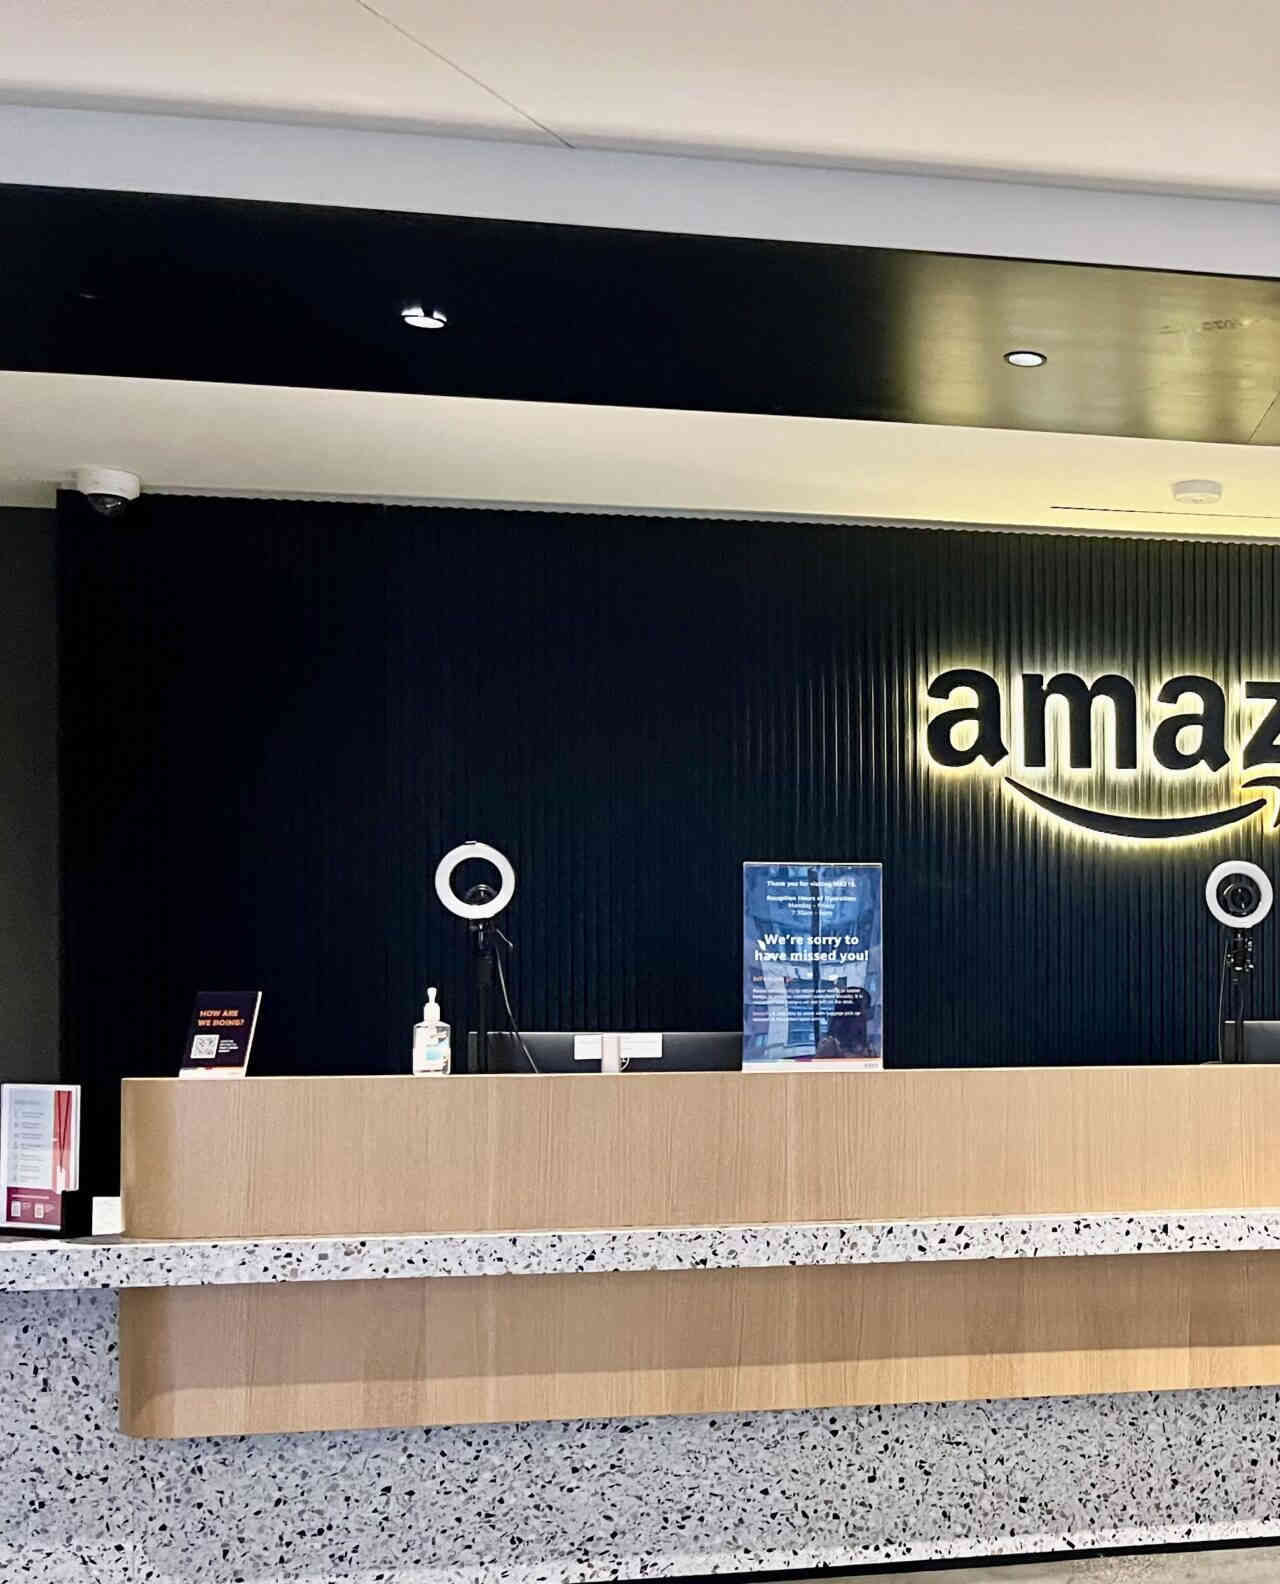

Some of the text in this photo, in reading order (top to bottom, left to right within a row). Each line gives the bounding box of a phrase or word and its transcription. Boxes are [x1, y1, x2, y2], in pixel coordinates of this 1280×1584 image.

[807, 935, 842, 948] sorry
[845, 935, 860, 945] to
[754, 950, 869, 963] have missed you!
[222, 1009, 239, 1017] ARE
[212, 1019, 245, 1027] DOING?
